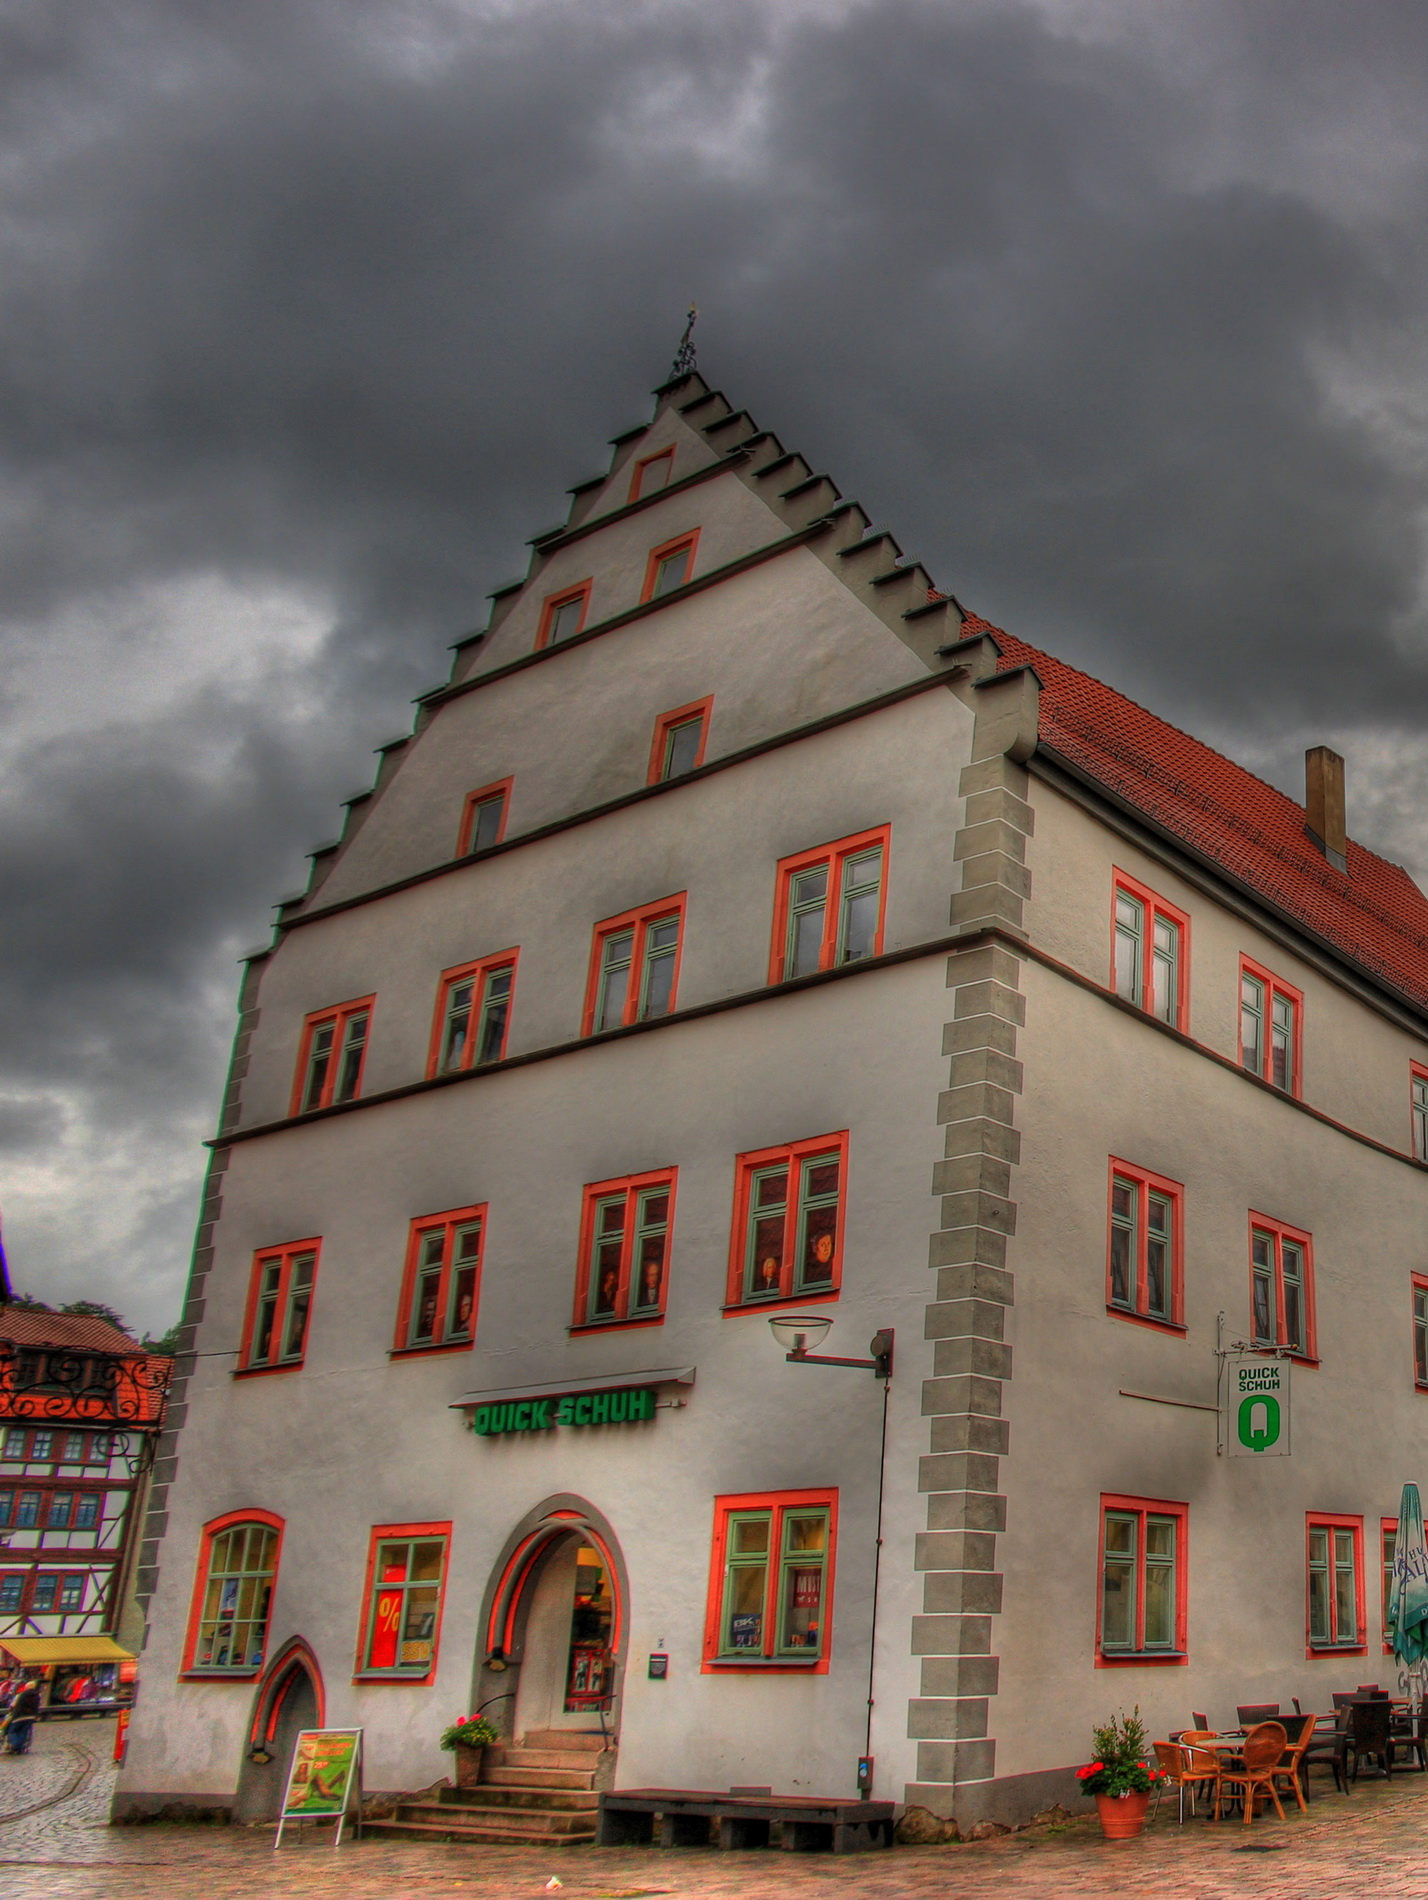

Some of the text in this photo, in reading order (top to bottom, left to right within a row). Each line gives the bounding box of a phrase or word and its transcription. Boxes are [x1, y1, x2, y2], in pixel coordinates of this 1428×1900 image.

[1238, 1367, 1280, 1381] QUICK
[1238, 1379, 1281, 1392] SCHUH
[474, 1389, 651, 1436] QUICK SCHUH
[1237, 1394, 1281, 1453] Q
